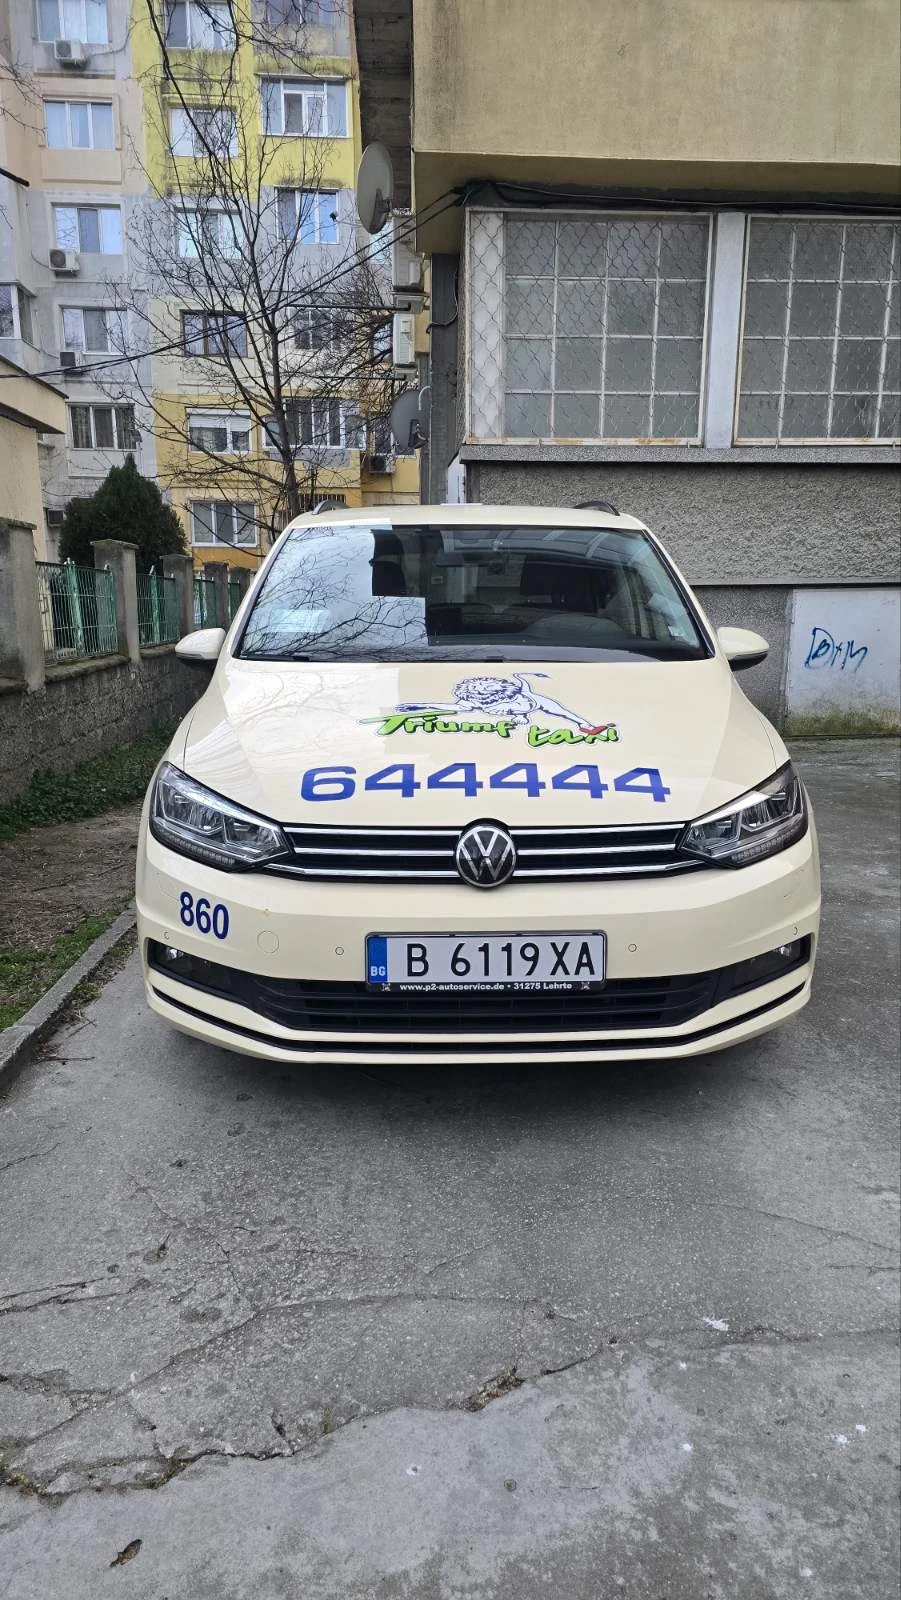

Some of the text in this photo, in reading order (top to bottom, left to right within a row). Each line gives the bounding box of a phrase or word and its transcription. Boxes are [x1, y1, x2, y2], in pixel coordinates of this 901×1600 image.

[359, 710, 619, 747] Triumf taxi
[300, 762, 671, 803] 644444
[179, 891, 230, 940] 860
[370, 966, 386, 977] BG
[406, 942, 595, 977] B 6119 XA
[399, 982, 573, 992] www.p2-autoservice.de 31275 Lehrte
